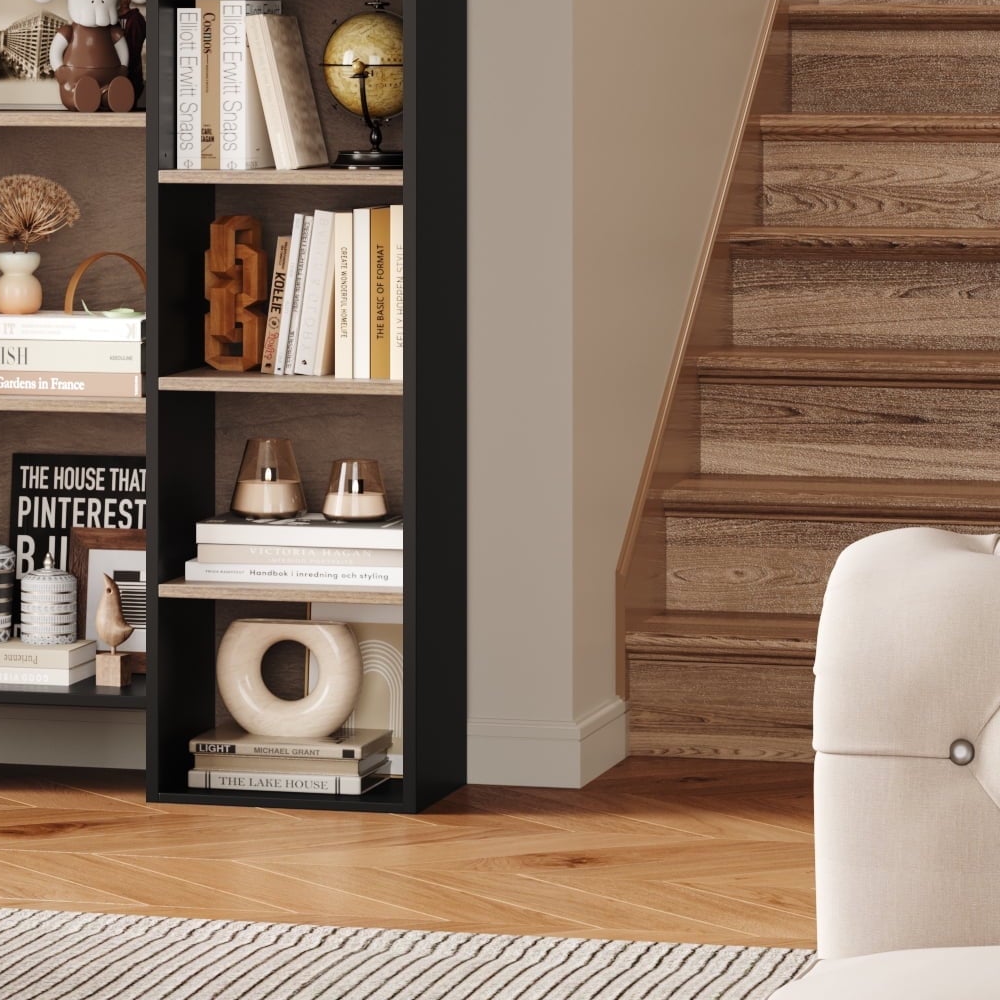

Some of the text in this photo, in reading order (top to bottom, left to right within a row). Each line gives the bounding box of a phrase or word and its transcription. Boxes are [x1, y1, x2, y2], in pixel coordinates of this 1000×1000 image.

[202, 12, 216, 54] Cosmos
[180, 12, 198, 151] Elliott Erwitt Snaps
[223, 4, 242, 151] Elliott Erwitt Snaps
[270, 272, 286, 315] KOFFIE
[376, 244, 384, 340] THE BASIC OF FORMAT
[3, 323, 16, 335] IT
[38, 378, 48, 390] in
[50, 378, 84, 390] France
[20, 466, 146, 492] THE HOUSE THAT
[18, 496, 146, 529] PINTEREST
[296, 571, 338, 580] inredning
[360, 572, 389, 581] styling
[200, 744, 231, 752] LIGHT
[254, 747, 289, 755] MICHAEL
[218, 776, 328, 790] THE LAKE HOUSE
